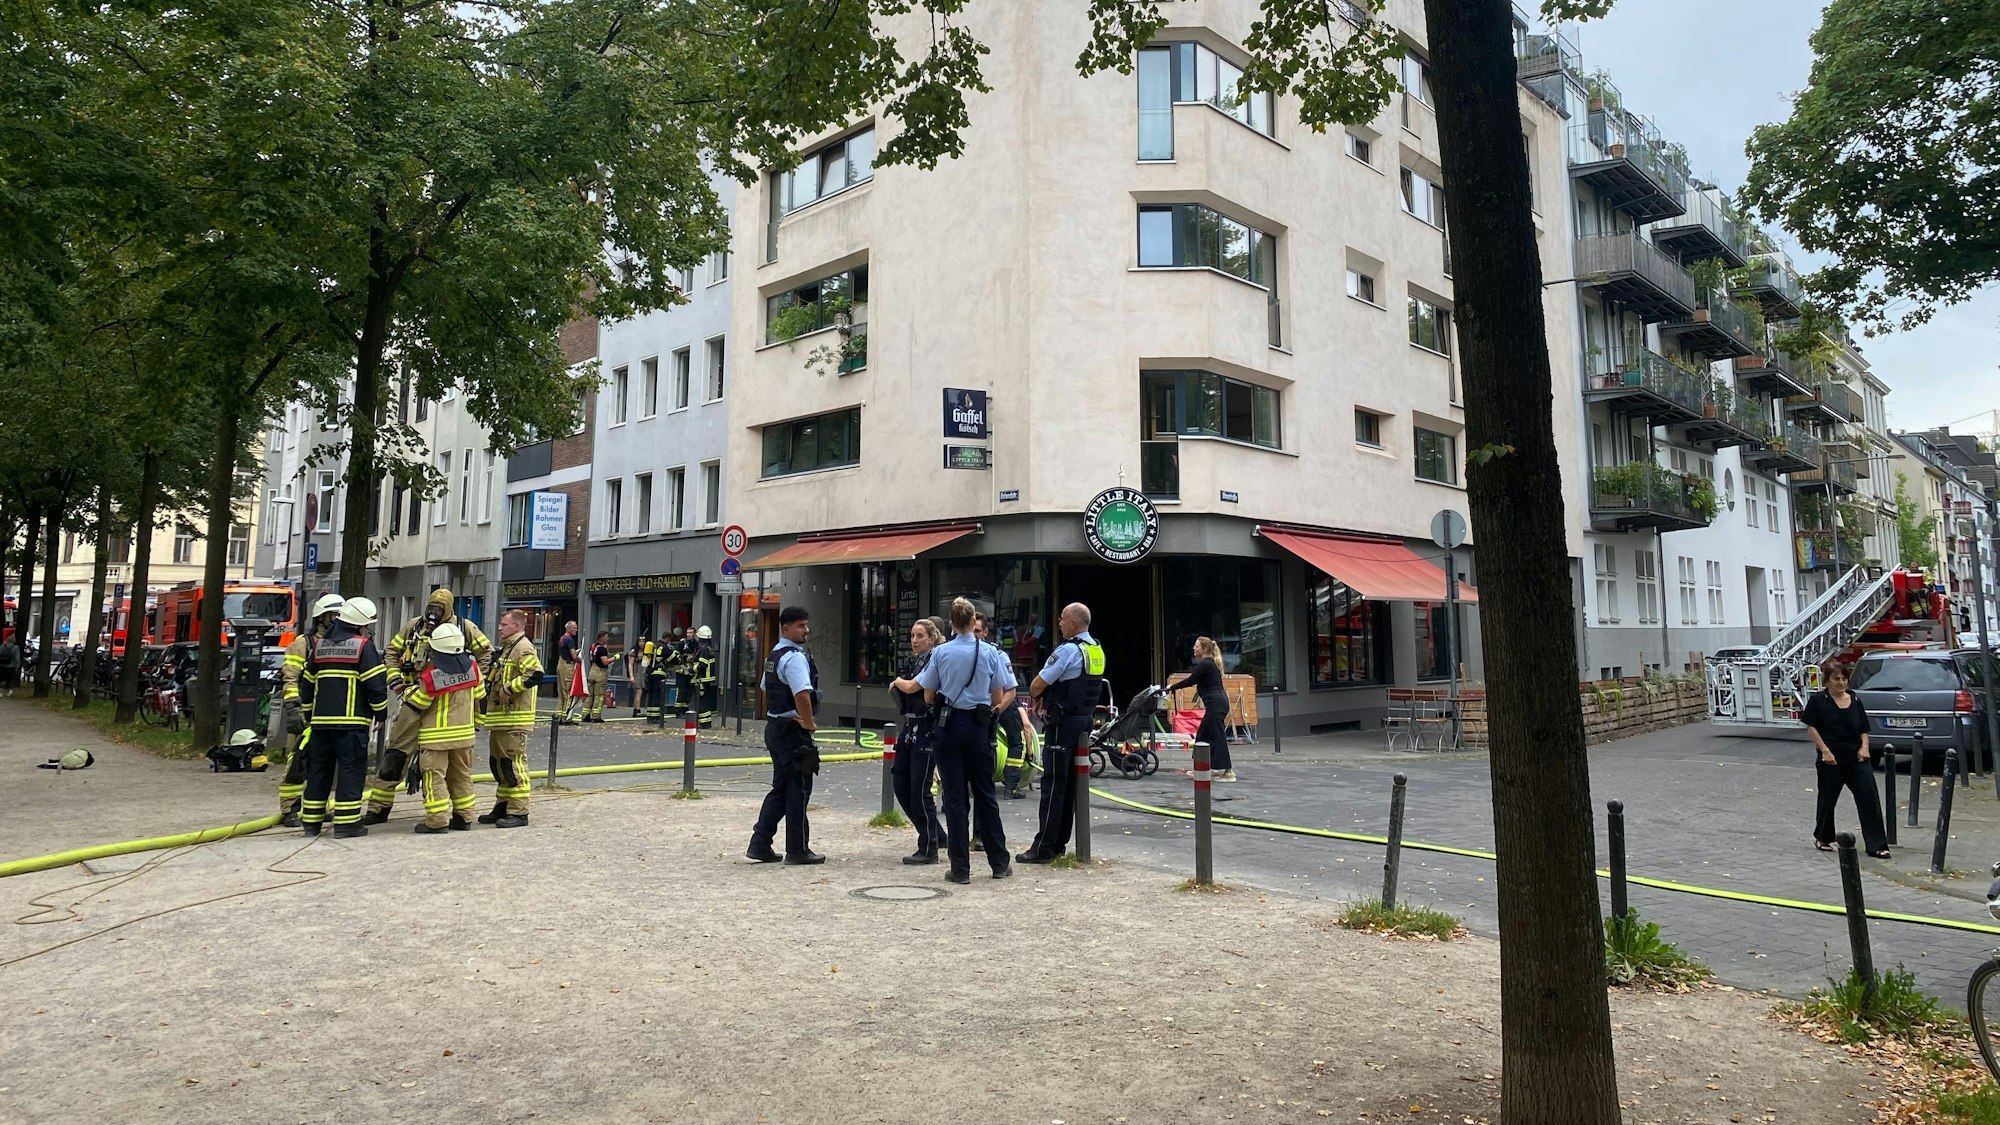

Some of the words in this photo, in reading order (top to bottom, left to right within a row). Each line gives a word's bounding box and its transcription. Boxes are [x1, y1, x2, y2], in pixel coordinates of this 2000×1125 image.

[952, 407, 984, 425] Gaffel
[958, 423, 979, 434] Kölsch
[537, 495, 563, 505] Spiegel
[540, 505, 560, 513] Bilder
[1085, 490, 1124, 527] LITTLE
[1126, 491, 1157, 528] ITALY
[535, 514, 563, 522] Rahmen
[541, 523, 557, 531] Glas
[727, 533, 742, 548] 30
[1104, 548, 1141, 560] RESTAURANT
[1142, 535, 1154, 549] BAR
[528, 581, 572, 595] SPIEGELHAUS
[442, 676, 456, 687] LG
[457, 673, 470, 683] RD
